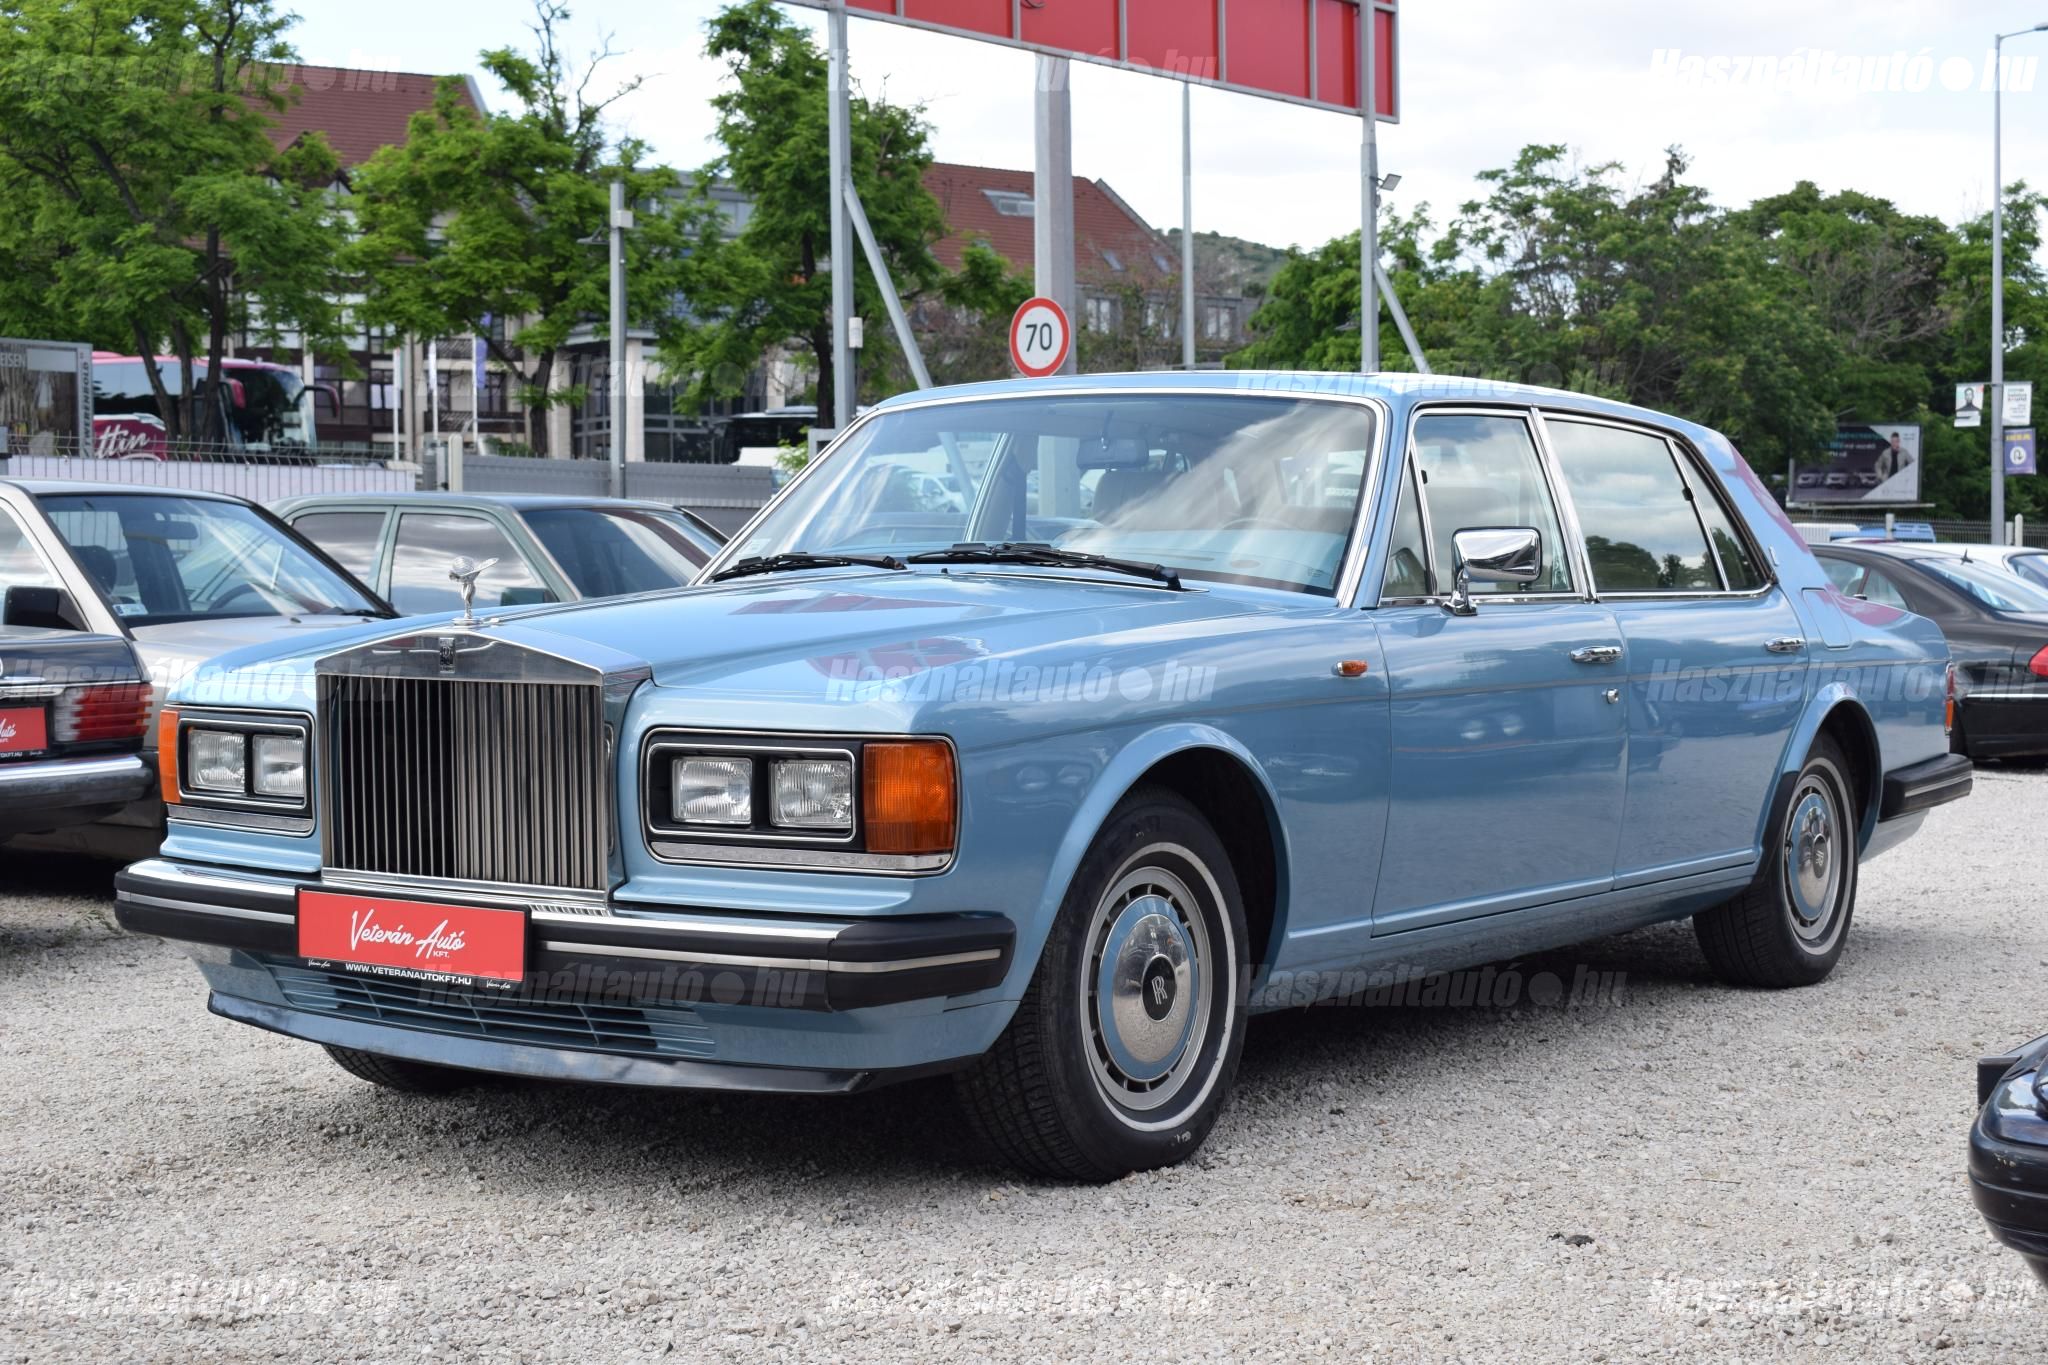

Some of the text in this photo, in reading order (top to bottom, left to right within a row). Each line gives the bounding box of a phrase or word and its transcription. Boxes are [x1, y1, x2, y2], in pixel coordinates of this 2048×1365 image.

[1025, 322, 1053, 352] 70
[351, 908, 465, 959] Veterán Autó
[432, 950, 450, 959] KFT.
[345, 962, 472, 985] WWW.VETERANAUTOKFT.HU
